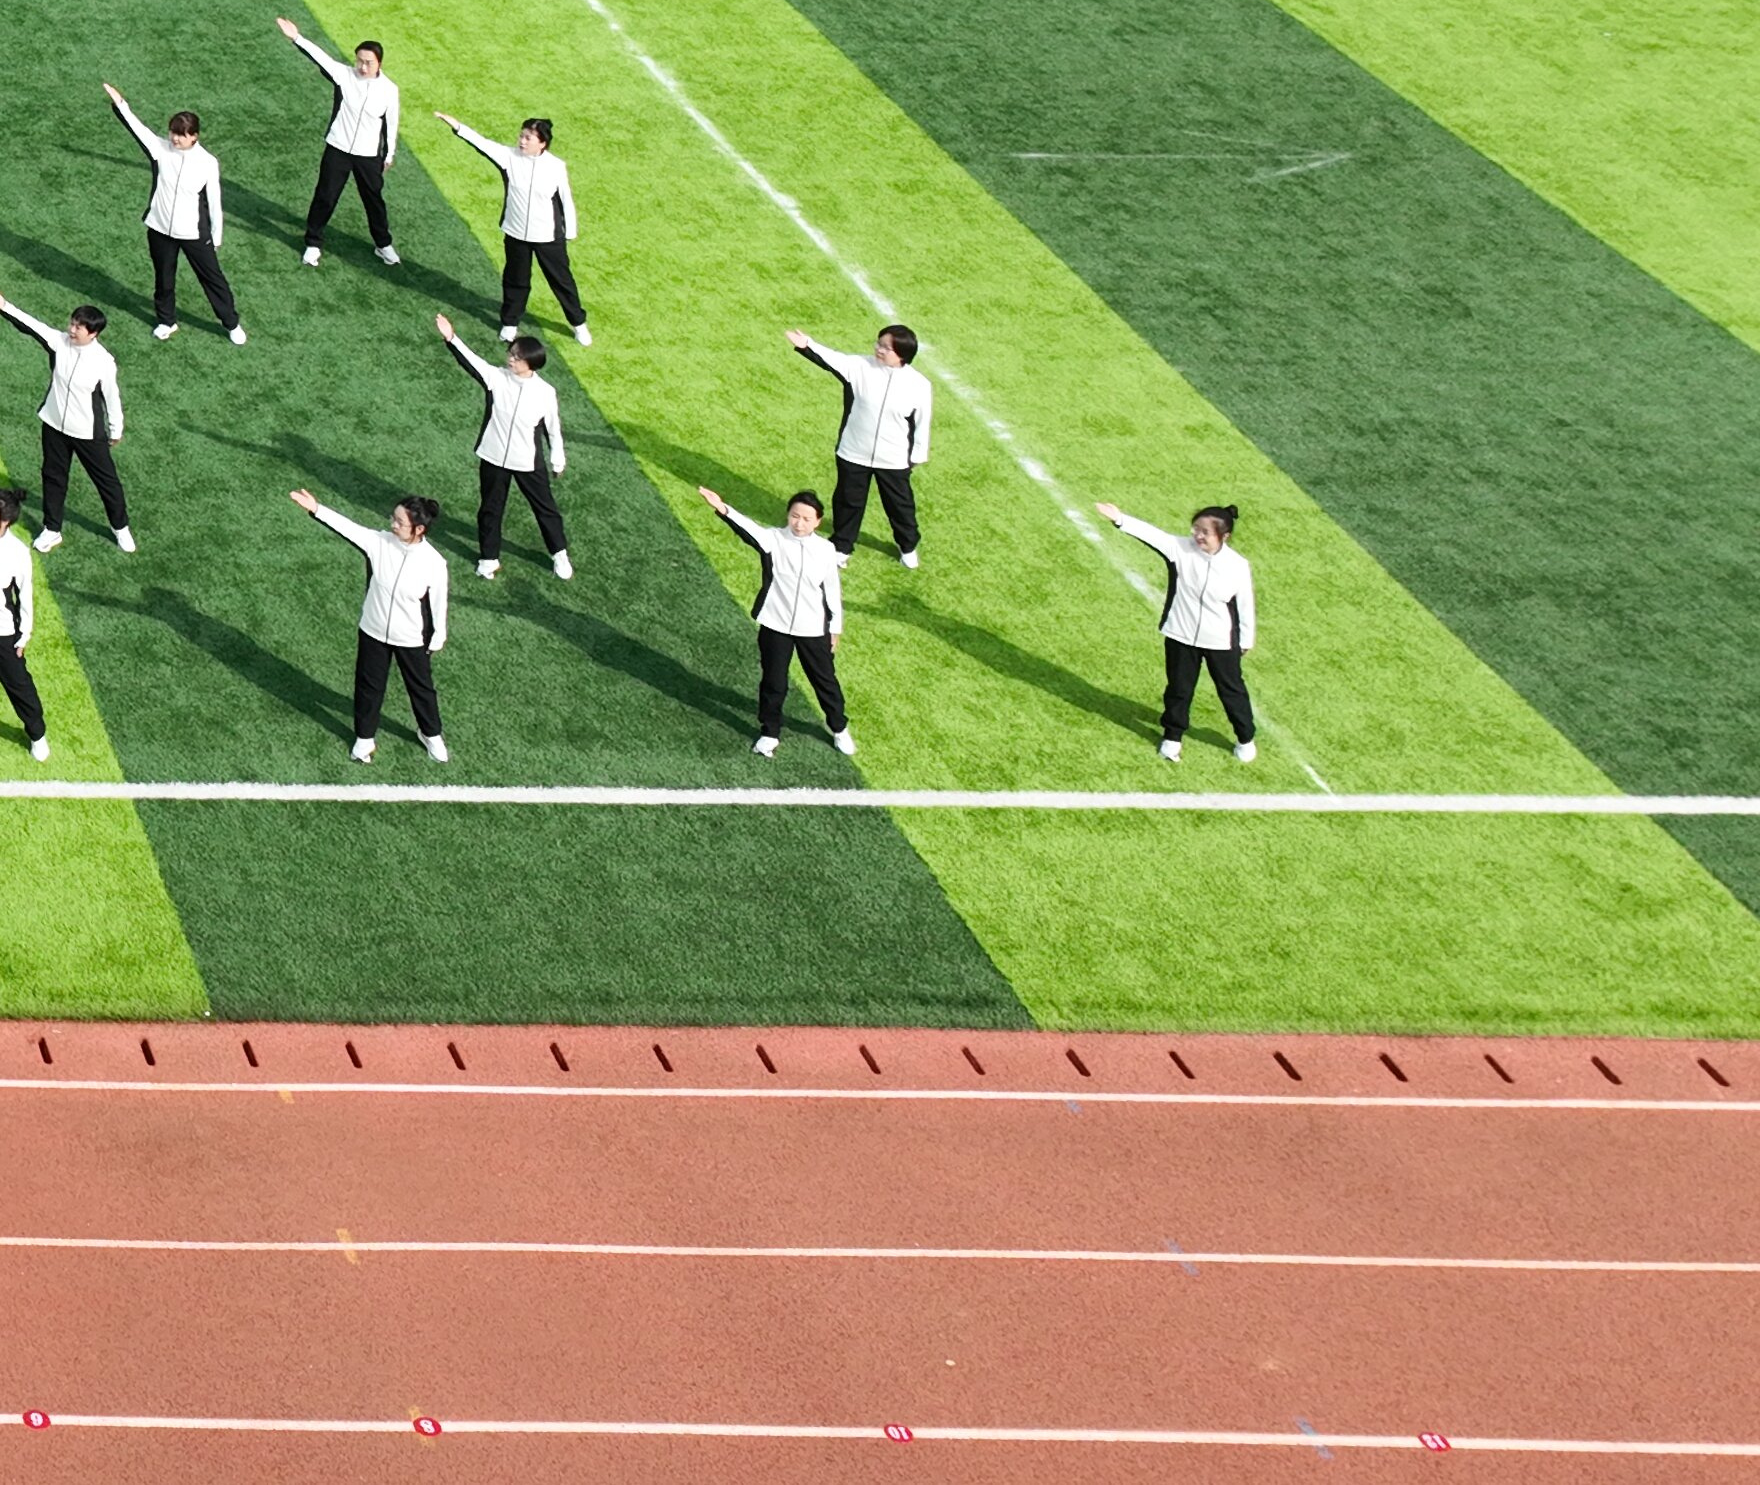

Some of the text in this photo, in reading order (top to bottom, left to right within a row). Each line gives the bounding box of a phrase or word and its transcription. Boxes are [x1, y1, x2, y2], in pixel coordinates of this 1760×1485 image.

[30, 1412, 44, 1427] 6
[887, 1426, 909, 1440] 10
[1421, 1435, 1447, 1449] 12
